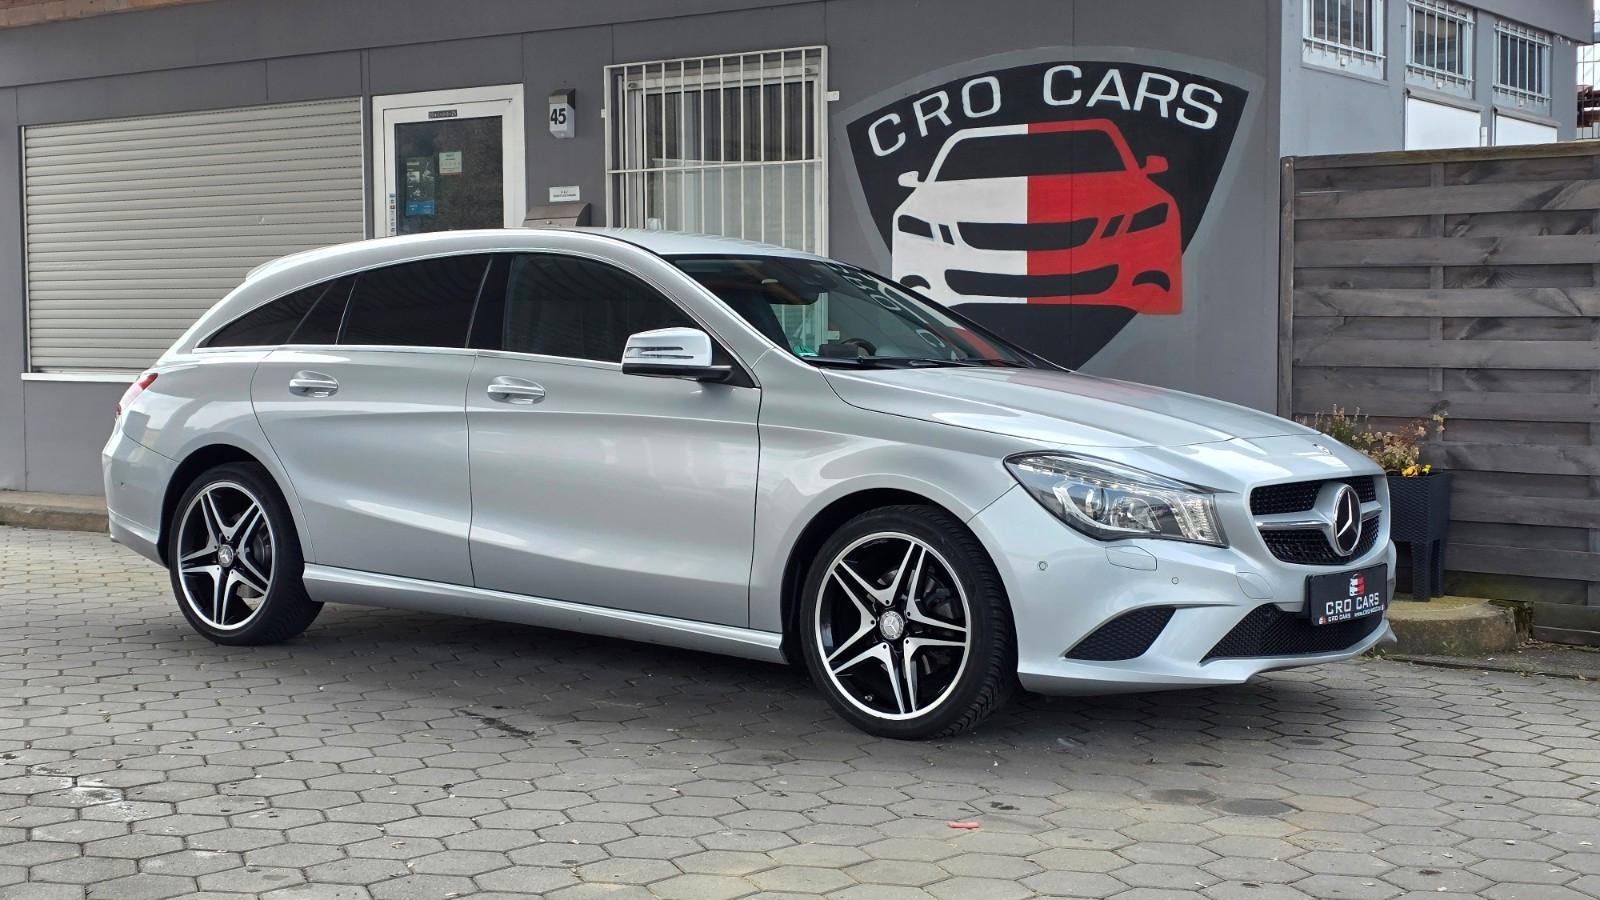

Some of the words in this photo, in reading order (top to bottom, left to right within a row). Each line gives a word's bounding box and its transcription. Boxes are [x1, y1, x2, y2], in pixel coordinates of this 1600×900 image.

[550, 108, 566, 125] 45
[867, 75, 1001, 157] CRO
[1042, 64, 1223, 130] CARS
[1325, 598, 1352, 615] CRO
[1356, 592, 1379, 610] CARS
